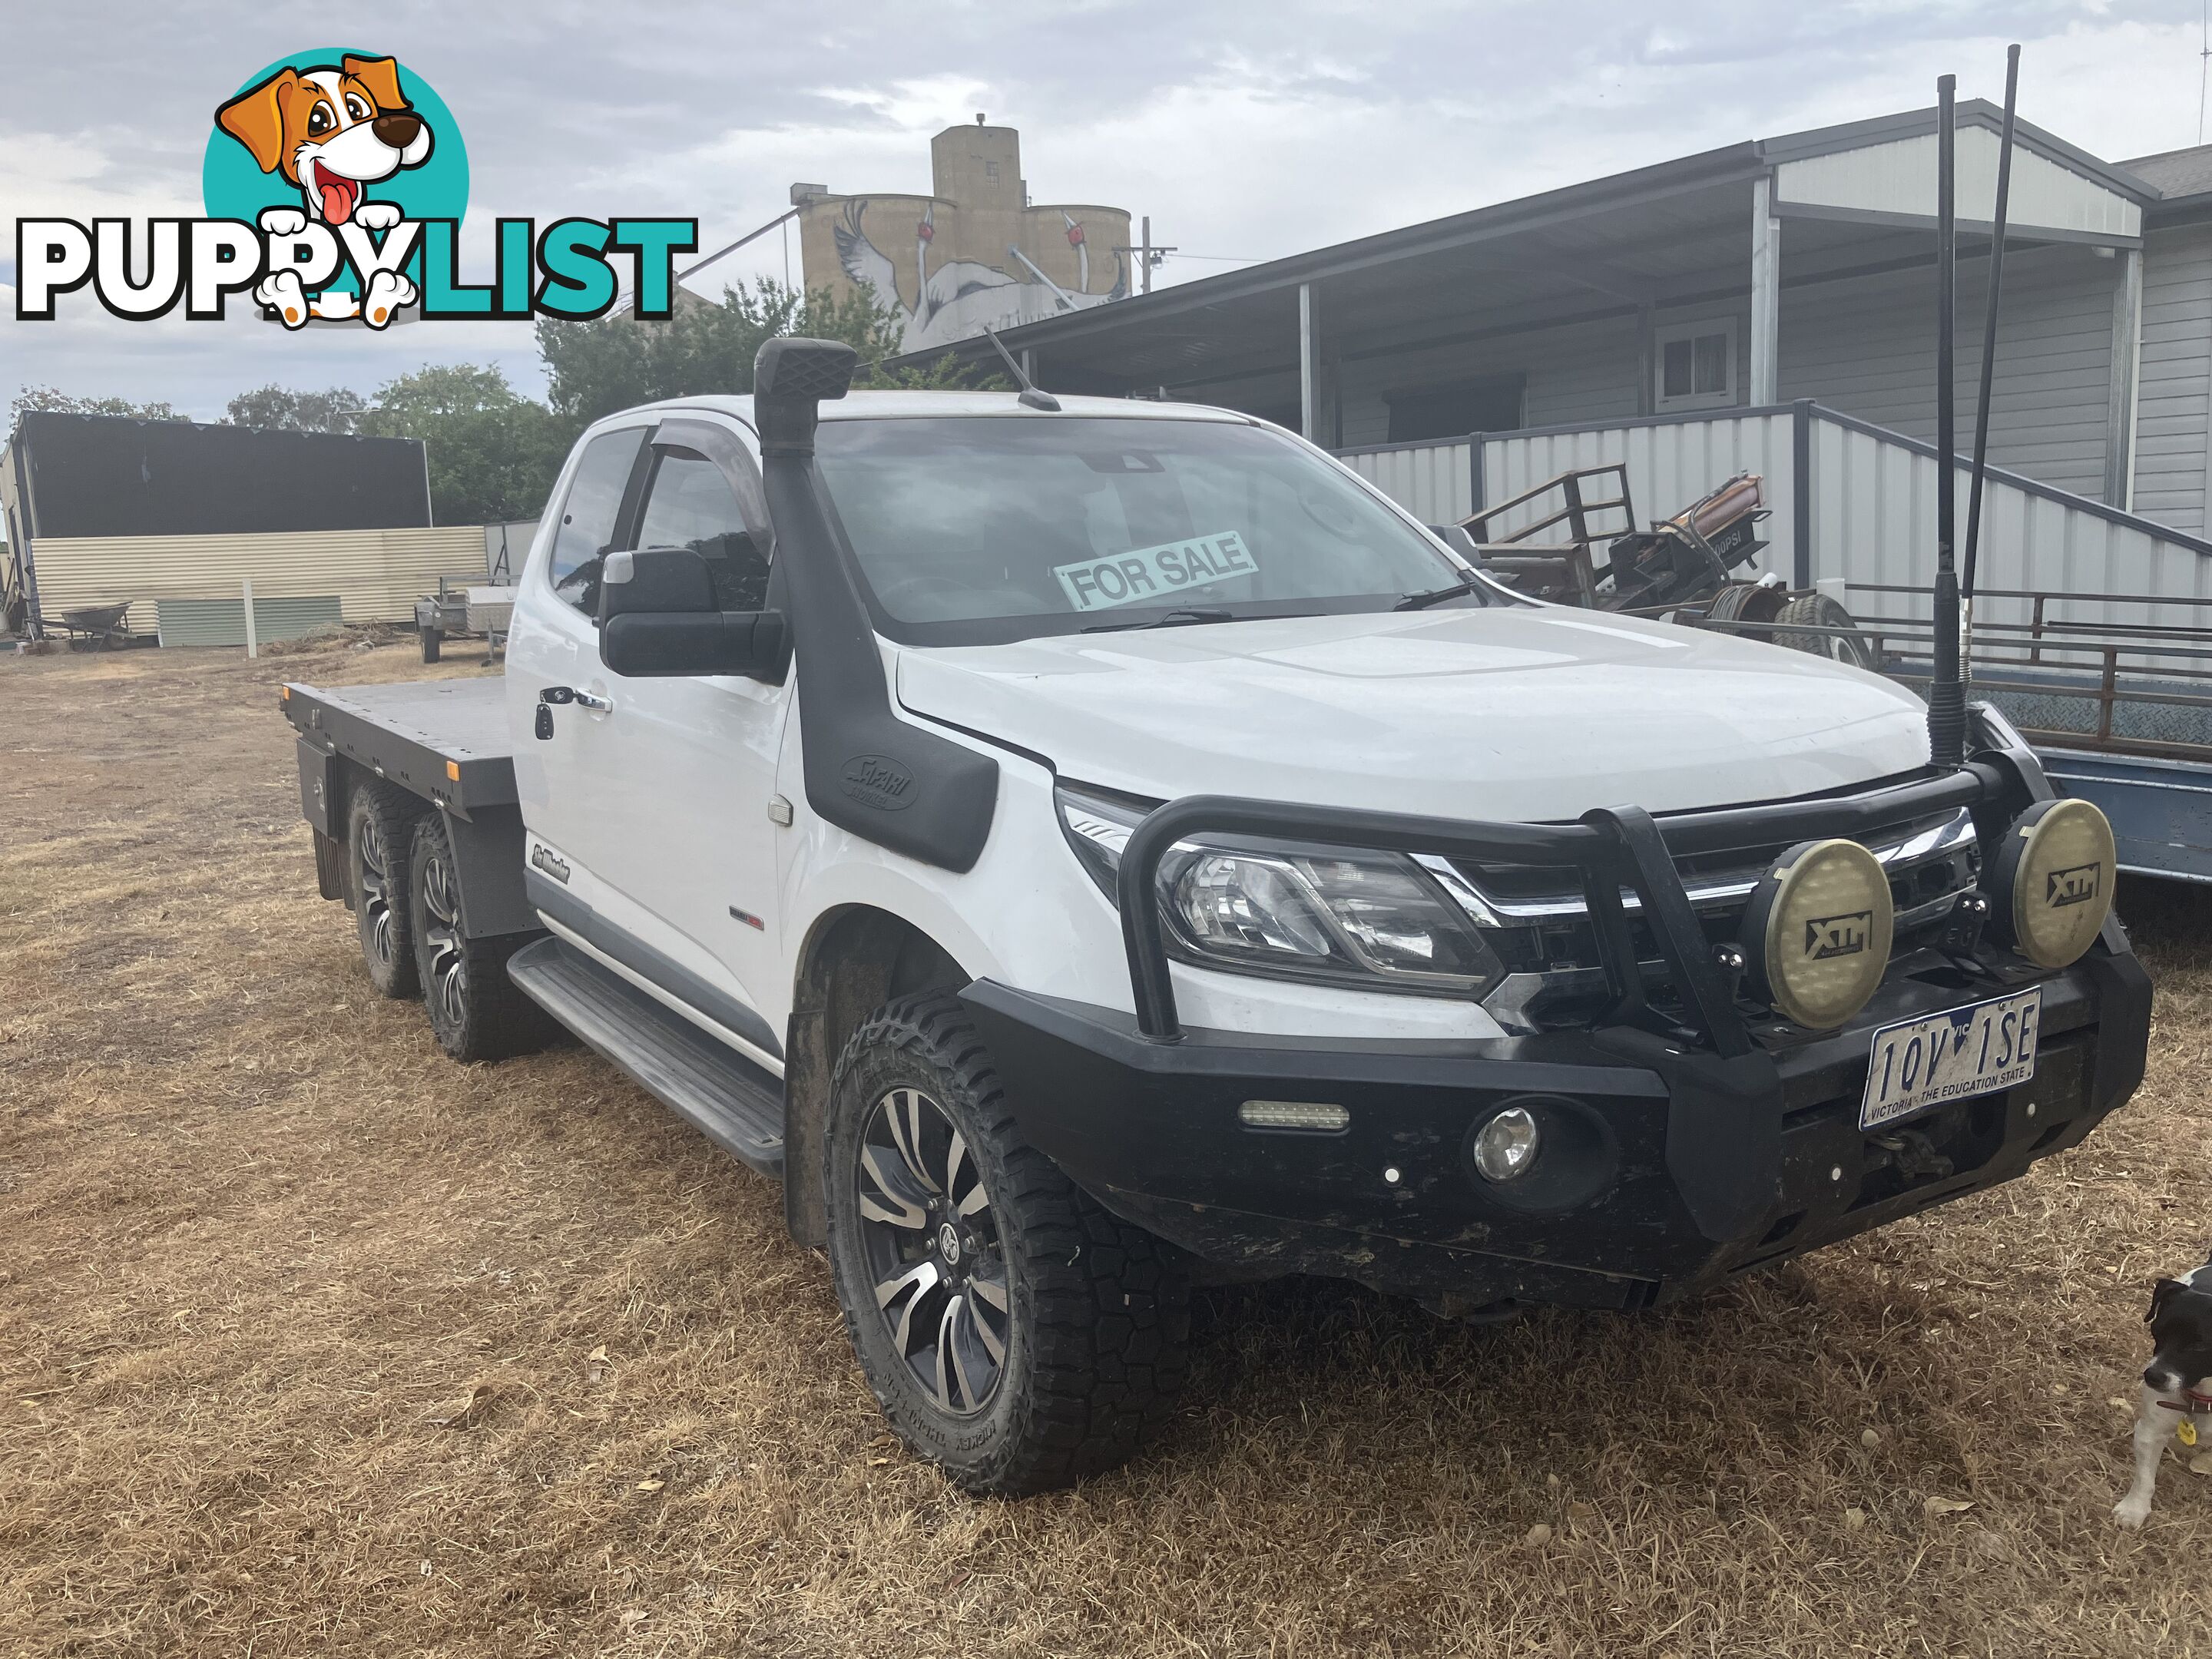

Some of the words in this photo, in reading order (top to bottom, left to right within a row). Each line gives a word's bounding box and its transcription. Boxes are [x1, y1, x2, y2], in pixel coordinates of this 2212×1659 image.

[1068, 558, 1157, 606] FOR
[1155, 538, 1249, 585] SALE
[847, 757, 911, 796] SAFARI
[2046, 862, 2101, 908] XTM
[1805, 911, 1873, 960] XTM
[1953, 1022, 1970, 1037] VIC
[1870, 1096, 1912, 1121] VICTORIA
[1920, 1087, 1939, 1103] THE
[1941, 1075, 1998, 1098] EDUCATION
[1999, 1066, 2025, 1085] STATE
